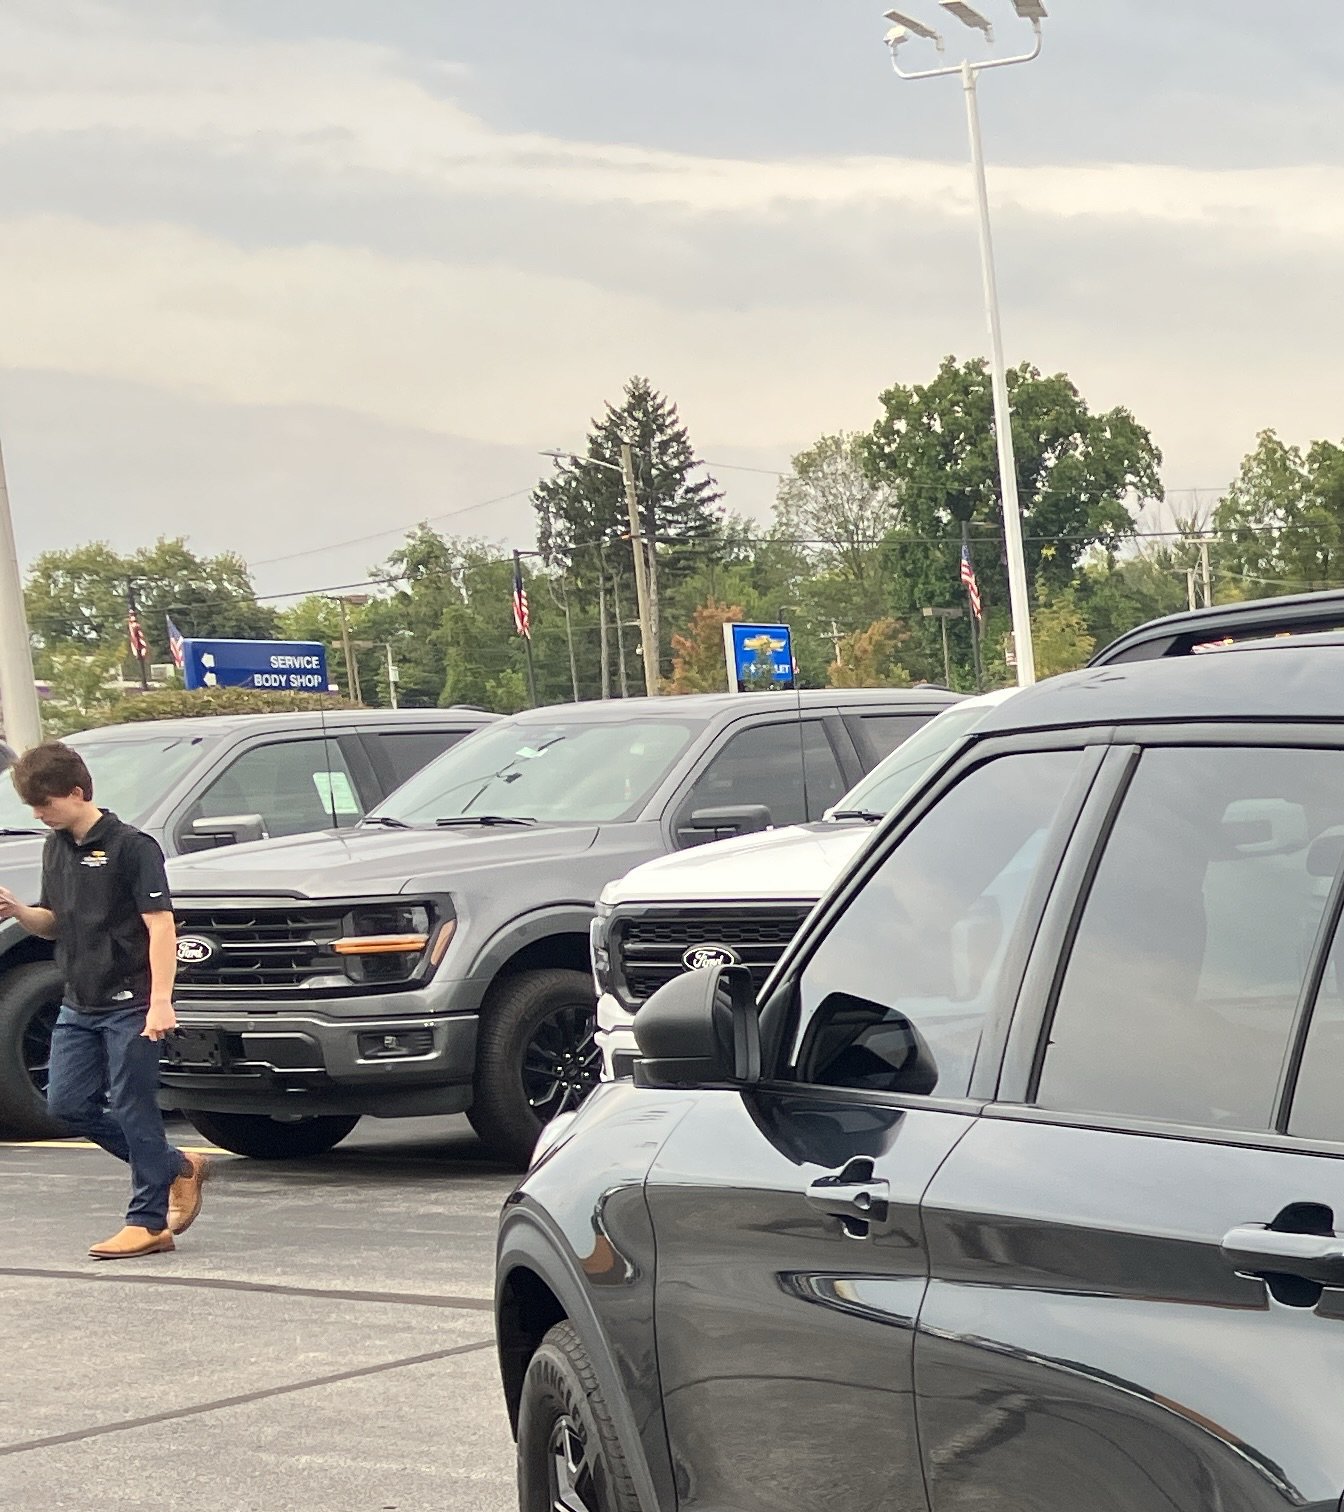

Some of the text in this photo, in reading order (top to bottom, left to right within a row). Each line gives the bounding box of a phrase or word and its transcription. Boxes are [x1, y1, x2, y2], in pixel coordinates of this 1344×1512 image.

[270, 655, 320, 669] SERVICE
[253, 673, 322, 687] BODY SHOP
[178, 941, 204, 959] Ford
